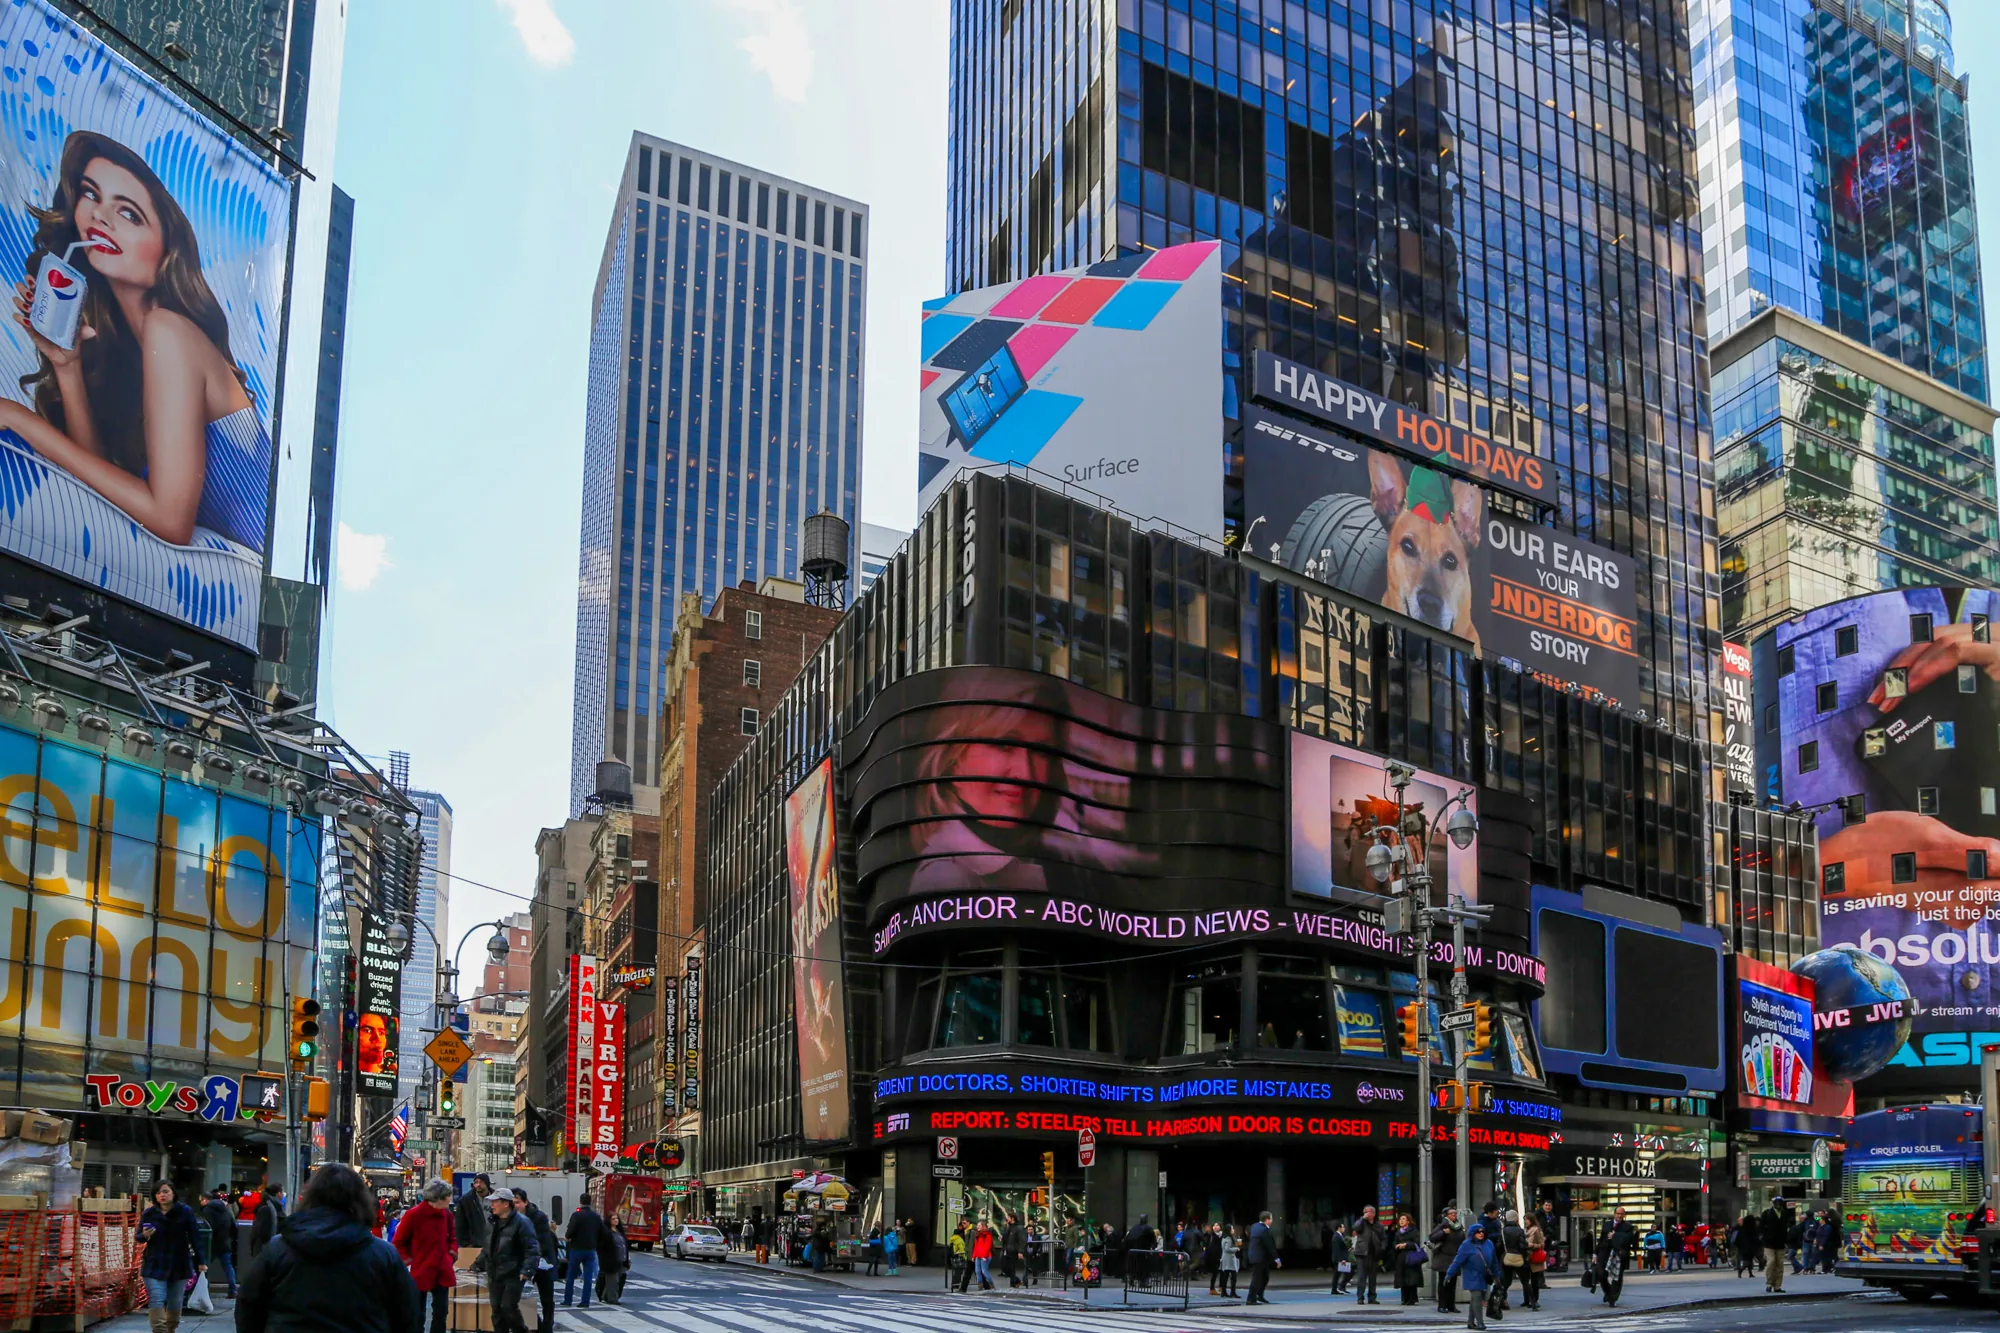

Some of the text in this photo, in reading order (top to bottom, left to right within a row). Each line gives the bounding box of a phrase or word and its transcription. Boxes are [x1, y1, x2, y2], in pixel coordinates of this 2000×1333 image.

[37, 291, 50, 324] pepsi
[1274, 360, 1543, 490] HAPPY HOLIDAYS
[1254, 420, 1358, 462] NITTO
[1063, 458, 1139, 484] Surface
[963, 480, 976, 607] 1500
[1488, 520, 1620, 589] OUR EARS
[1536, 568, 1579, 598] YOUR
[1530, 631, 1589, 665] STORY
[1724, 676, 1746, 702] ALL
[1894, 715, 1932, 744] My Passport
[1824, 901, 1839, 915] is
[1844, 893, 1907, 912] saving
[1914, 889, 1954, 906] your
[792, 866, 838, 970] SPLASH
[1916, 907, 1949, 925] just
[1954, 906, 1980, 920] the
[910, 896, 1017, 928] ANCHOR
[1041, 899, 1093, 927] ABC
[1098, 907, 1186, 938] WORLD
[1193, 910, 1270, 936] NEWS
[1425, 940, 1453, 962] :30
[1463, 946, 1481, 967] M
[1497, 951, 1534, 977] DON'T
[363, 956, 399, 971] $10,000
[368, 972, 393, 984] Buzzed
[370, 981, 392, 992] driving
[613, 968, 655, 983] VIRGIL'S
[688, 970, 697, 997] TIMES
[372, 997, 390, 1007] drunk
[580, 966, 594, 1023] PARK
[667, 989, 676, 1014] TIMES
[369, 1005, 392, 1015] driving
[689, 998, 697, 1020] DELI
[1751, 996, 1803, 1024] Stylish and Sporty to
[1866, 1001, 1903, 1022] JVC
[1931, 1006, 1972, 1017] stream
[667, 1015, 675, 1035] DELI
[1444, 1018, 1453, 1026] ONE
[1744, 1010, 1810, 1041] Complement Your Lifestyle
[437, 1040, 459, 1048] SINGLE
[597, 1003, 619, 1143] VIRGILS
[579, 1058, 592, 1115] PARK
[919, 1074, 1014, 1093] DOCTORS,
[1020, 1075, 1096, 1098] SHORTER
[1100, 1083, 1153, 1102] SHIFTS
[1187, 1079, 1238, 1096] MORE
[1244, 1080, 1331, 1099] MISTAKES
[1357, 1084, 1404, 1101] abc NEWS
[1507, 1100, 1549, 1119] 'SHOCKED'
[930, 1111, 1371, 1137] REPORT: STEELERS TELL HARRISON DOOR IS CLOSED
[407, 1140, 438, 1149] BROADWAY
[594, 1143, 618, 1152] BBQ
[663, 1143, 679, 1151] Deli
[1493, 1129, 1516, 1147] RICA
[1081, 1152, 1091, 1160] ENTER
[1870, 1147, 1899, 1156] CIRQUE
[1914, 1145, 1943, 1153] SOLEIL
[1576, 1156, 1656, 1177] SEPHORA
[1750, 1158, 1811, 1166] STARBUCKS
